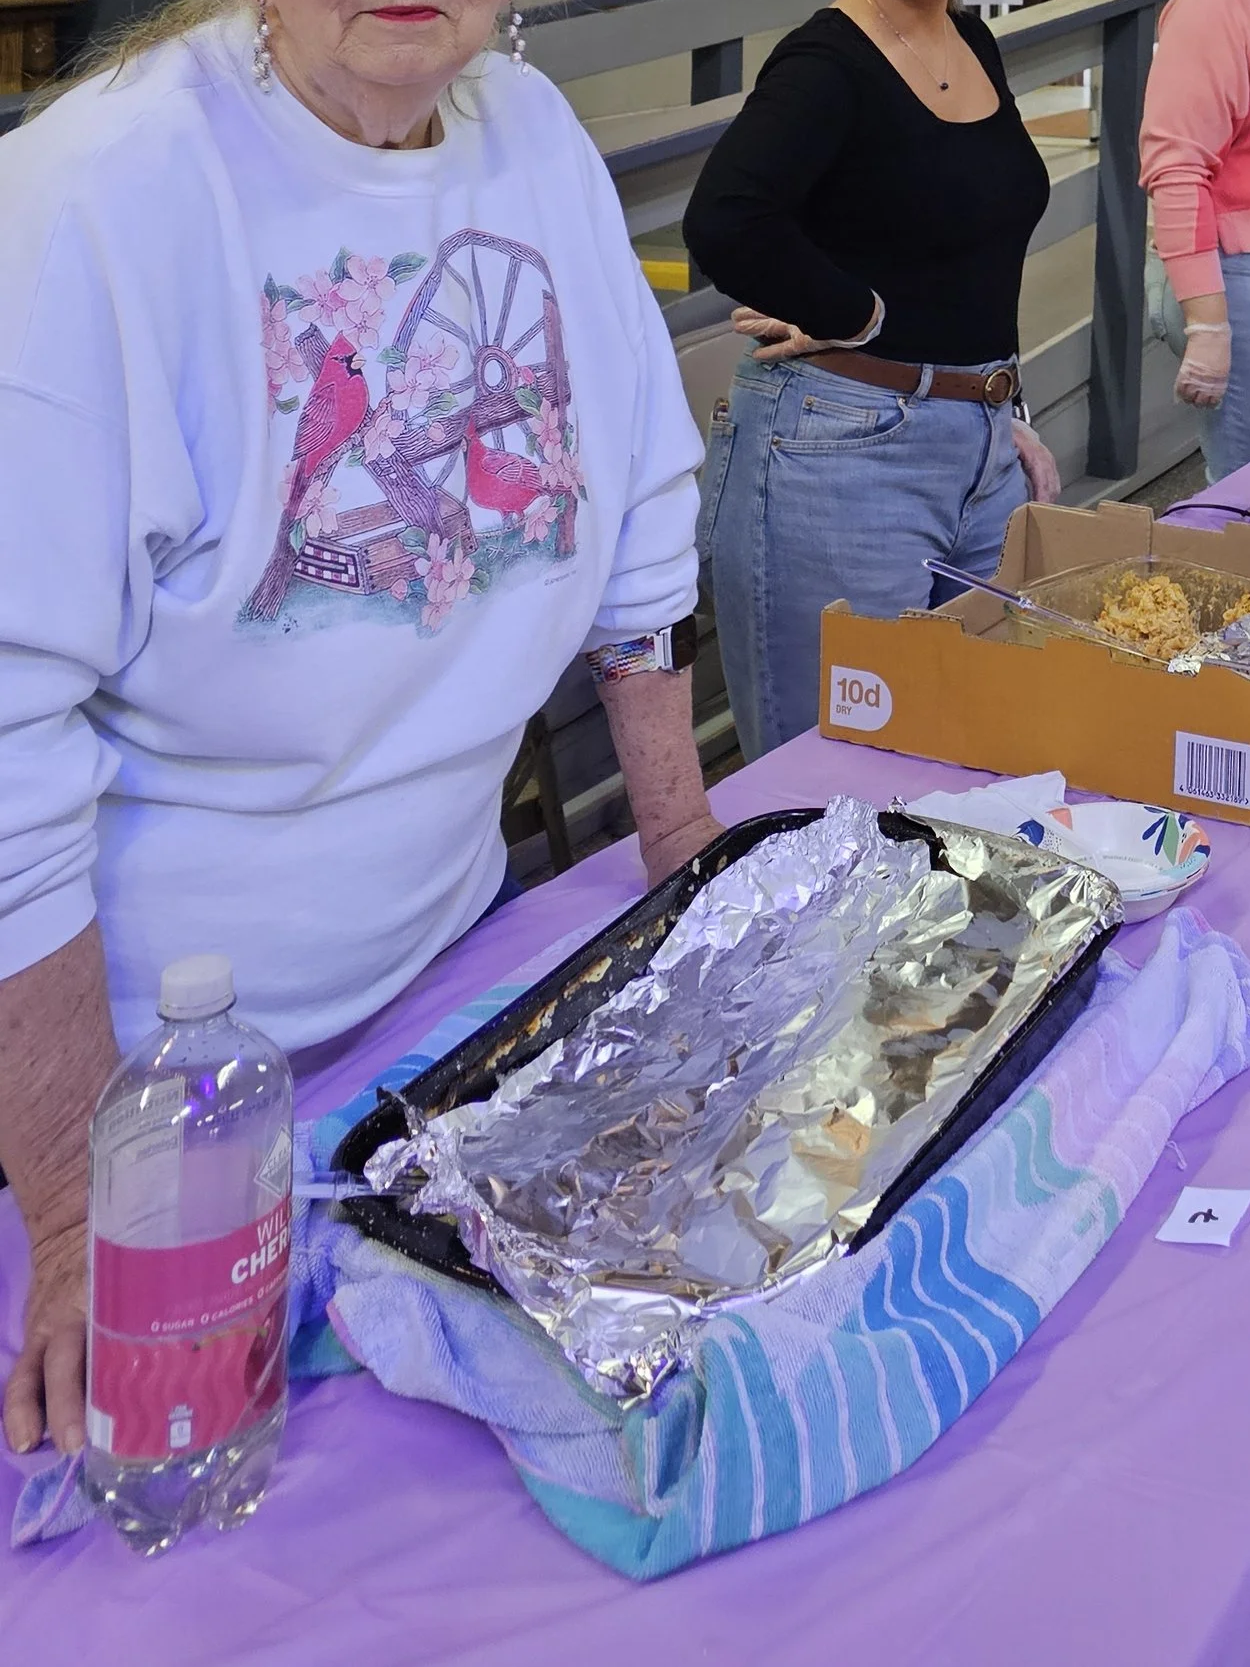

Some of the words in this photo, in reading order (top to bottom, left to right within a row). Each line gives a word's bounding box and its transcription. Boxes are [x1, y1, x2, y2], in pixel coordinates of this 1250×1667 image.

[837, 677, 880, 709] 10d
[835, 704, 852, 715] DRY
[162, 1318, 195, 1332] SUGAR
[211, 1295, 254, 1321] CALORIES
